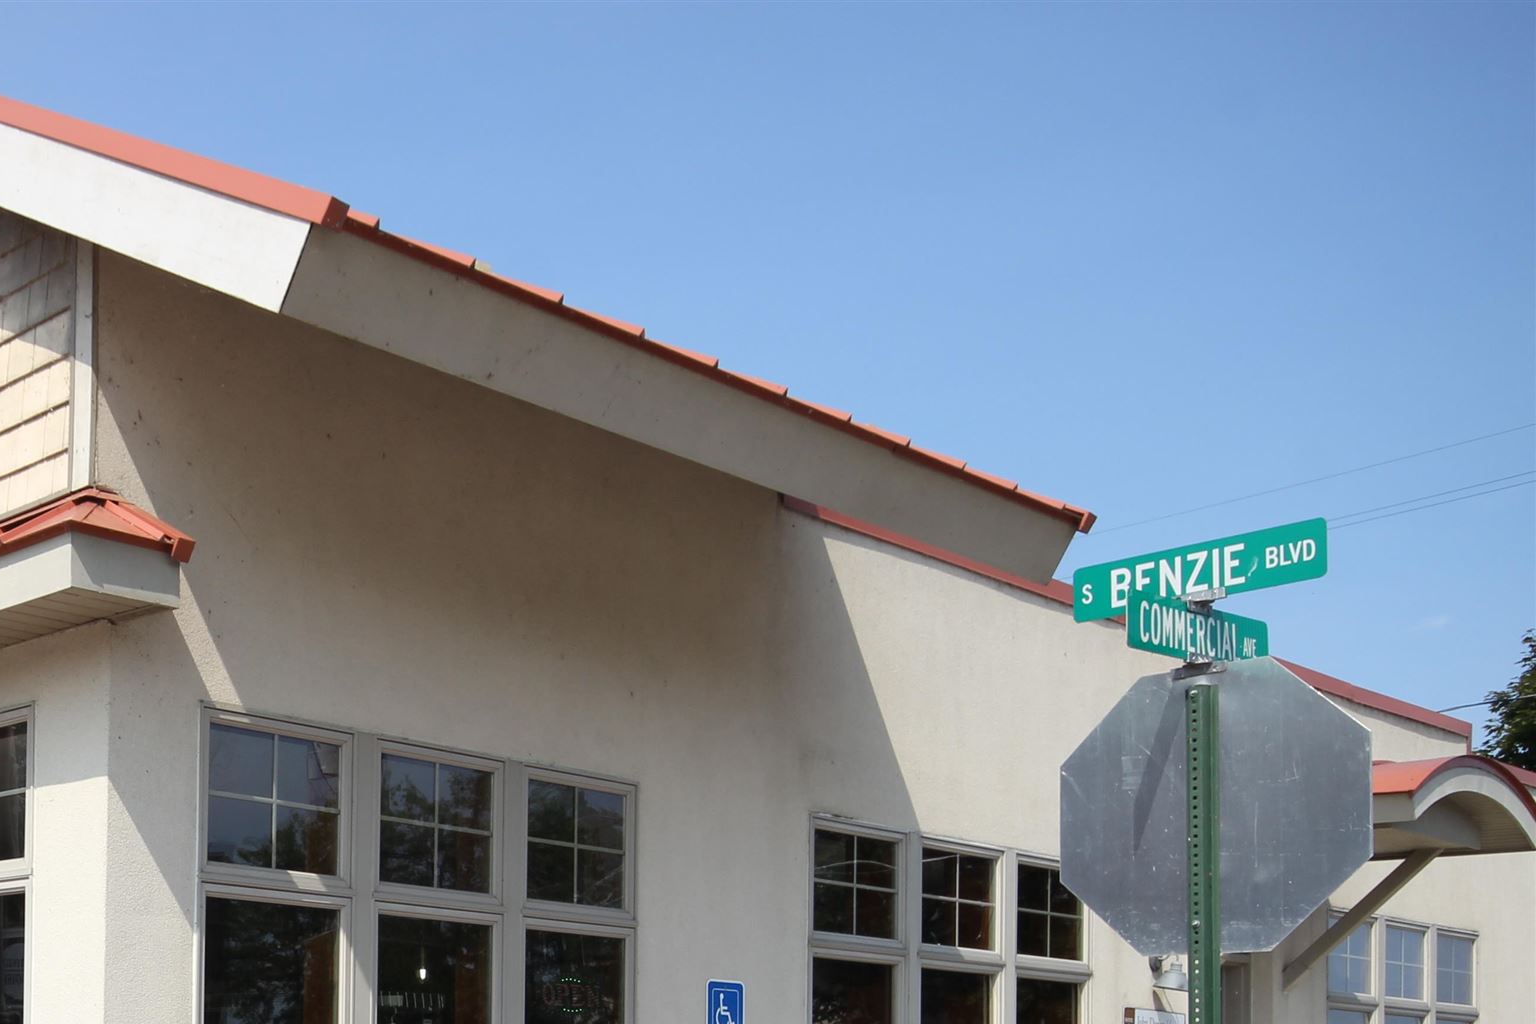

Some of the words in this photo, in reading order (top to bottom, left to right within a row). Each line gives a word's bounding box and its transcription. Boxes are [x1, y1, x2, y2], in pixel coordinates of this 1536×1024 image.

[1081, 583, 1093, 605] S
[1110, 543, 1246, 608] BENZIE
[1265, 539, 1316, 569] BLVD
[1139, 600, 1241, 661] COMMERCIAL
[1242, 637, 1258, 658] AVE
